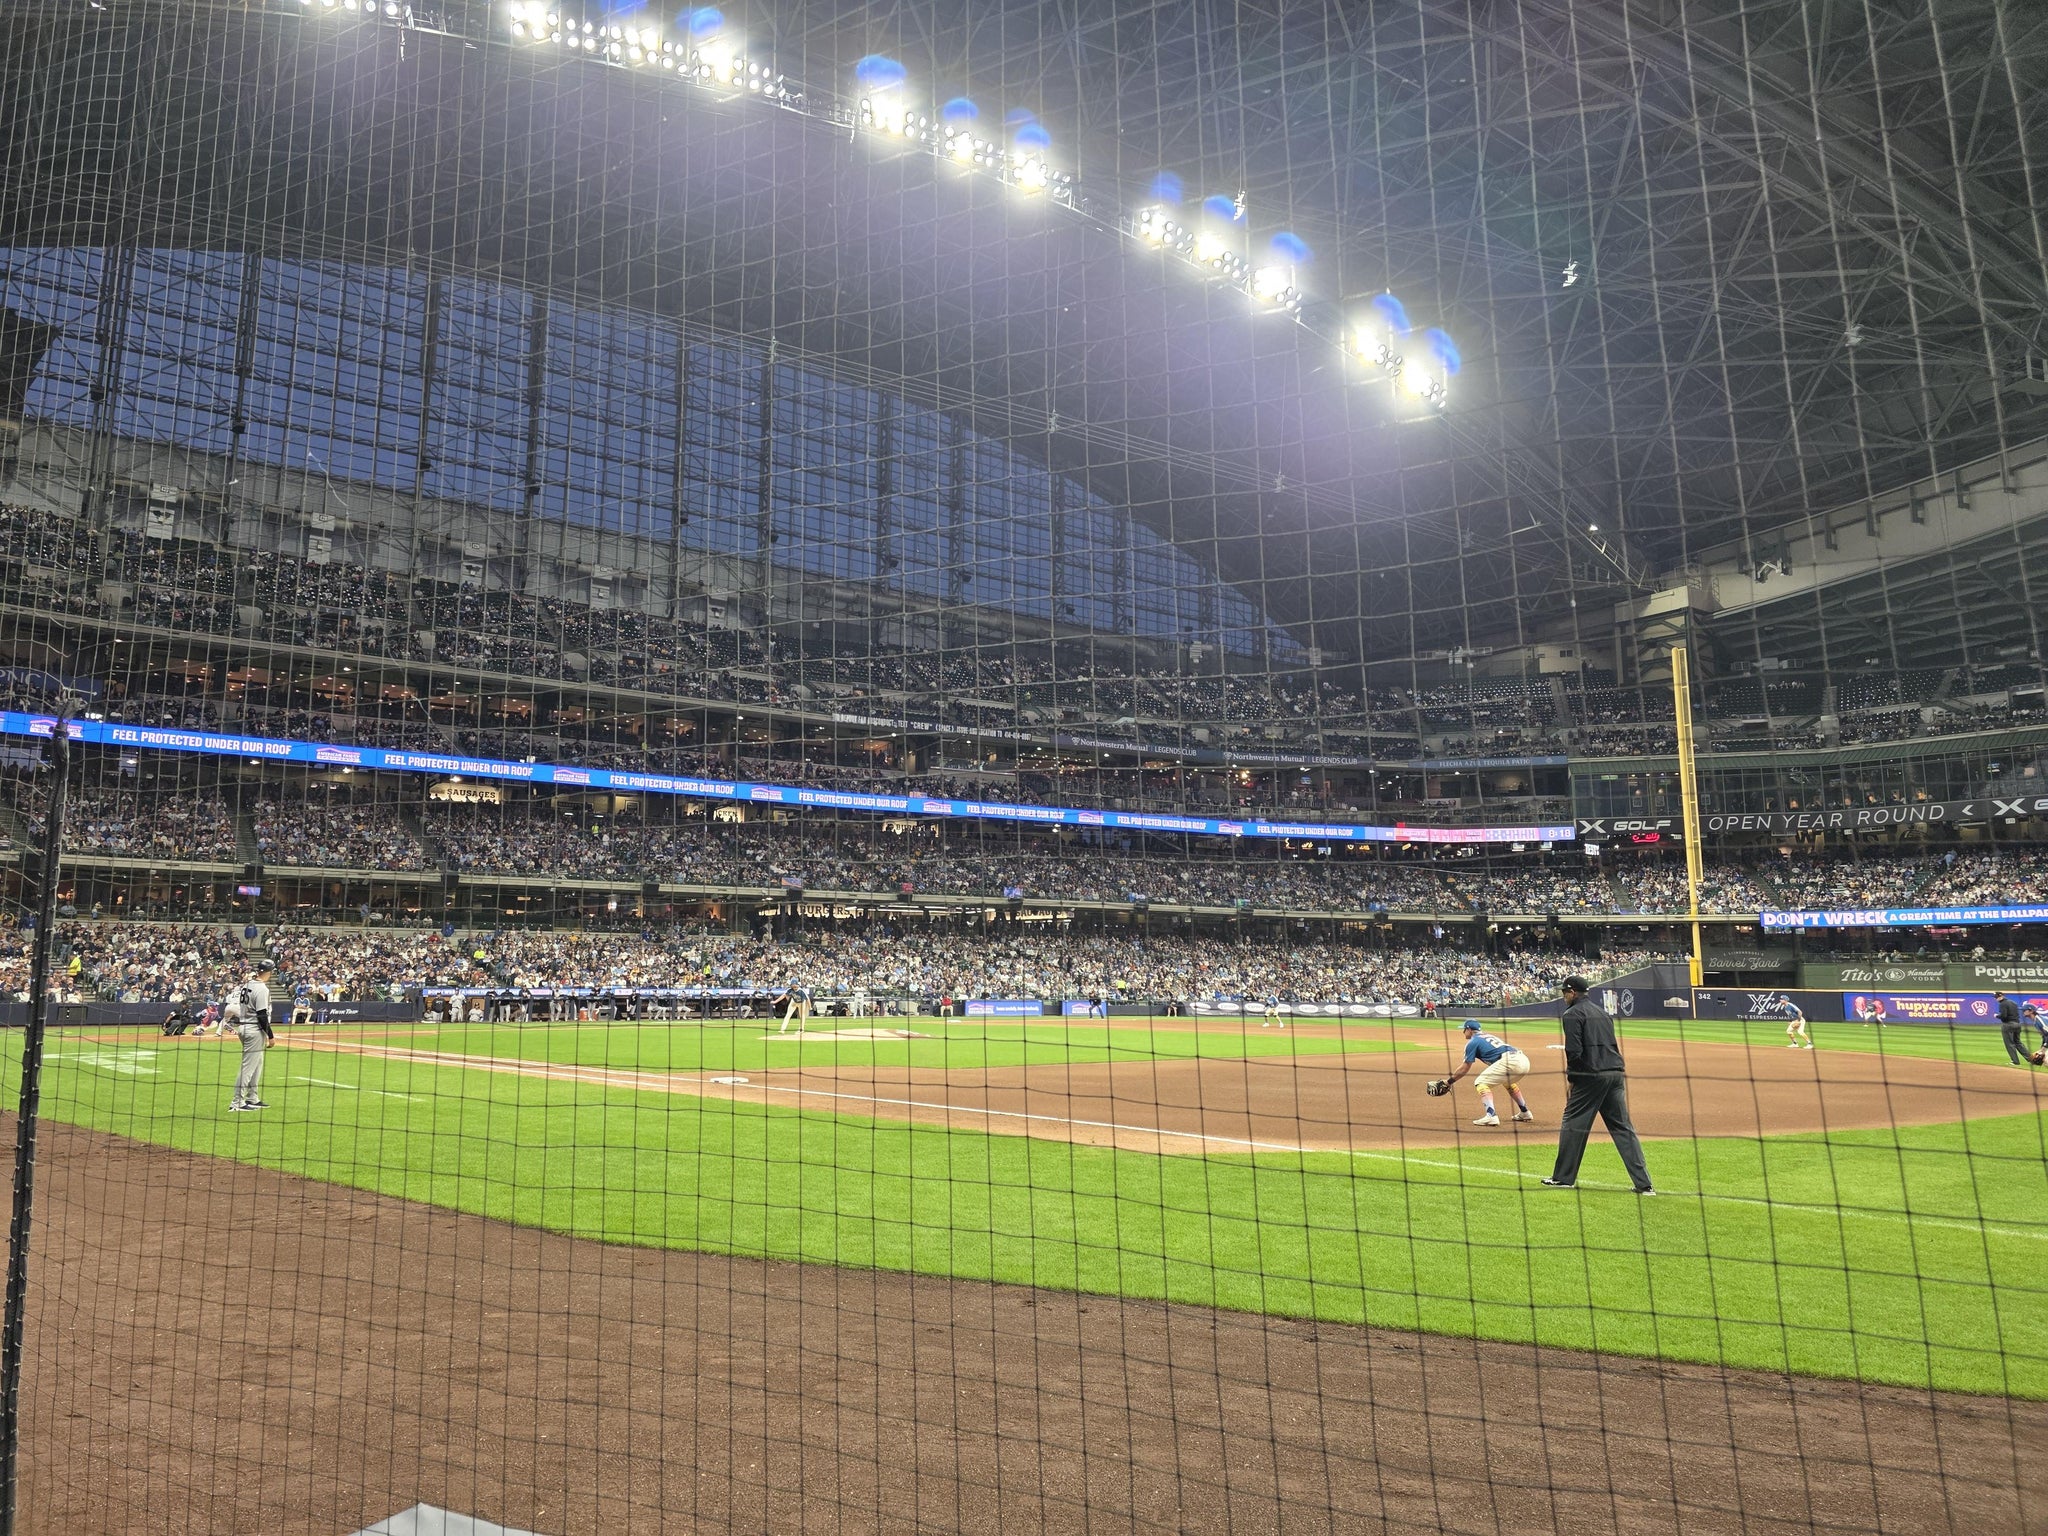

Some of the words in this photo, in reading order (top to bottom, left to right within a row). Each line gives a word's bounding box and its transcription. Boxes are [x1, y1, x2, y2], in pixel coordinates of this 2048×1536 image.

[112, 729, 138, 741] FEEL
[141, 732, 202, 747] PROTECTED
[205, 737, 240, 751] UNDER
[242, 741, 263, 753] OUR
[265, 743, 292, 755] ROOF
[1080, 738, 1124, 750] Northwestern
[1126, 744, 1148, 752] Mutual
[1154, 747, 1181, 755] LEGENDS
[1233, 753, 1280, 761] Northwestern
[385, 754, 406, 765] FEEL
[408, 756, 459, 770] PROTECTED
[461, 762, 490, 773] UNDER
[491, 764, 510, 775] OUR
[511, 766, 534, 776] ROOF
[610, 775, 628, 785] FEEL
[630, 777, 672, 789] PROTECTED
[674, 781, 698, 791] UNDER
[700, 783, 715, 792] OUR
[716, 785, 735, 794] ROOF
[447, 789, 496, 799] SAUSAGES
[799, 792, 814, 802] FEEL
[816, 793, 852, 804] PROTECTED
[854, 797, 875, 806] UNDER
[877, 799, 890, 808] OUR
[891, 800, 908, 809] ROOF
[1709, 816, 1772, 830] OPEN
[1782, 812, 1843, 829] YEAR
[1857, 805, 1944, 825] ROUND
[1257, 825, 1271, 834] FEEL
[1271, 826, 1305, 835] PROTECTED
[1305, 827, 1325, 835] UNDER
[1338, 829, 1353, 837] ROOF
[1580, 820, 1606, 833] X
[1613, 820, 1671, 831] GOLF
[1548, 829, 1571, 838] 8:18
[800, 905, 850, 915] BURGRS
[1899, 912, 1933, 921] GREAT
[1934, 912, 1961, 920] TIME
[1963, 911, 1977, 919] AT
[1977, 910, 1999, 919] THE
[1764, 913, 1820, 925] DON'T
[1822, 912, 1889, 925] WRECK
[1708, 958, 1746, 968] Barrel
[1748, 958, 1781, 970] Yard
[1841, 968, 1882, 981] Tito's
[240, 988, 252, 1005] 85
[1896, 1001, 1960, 1012] hupy.com
